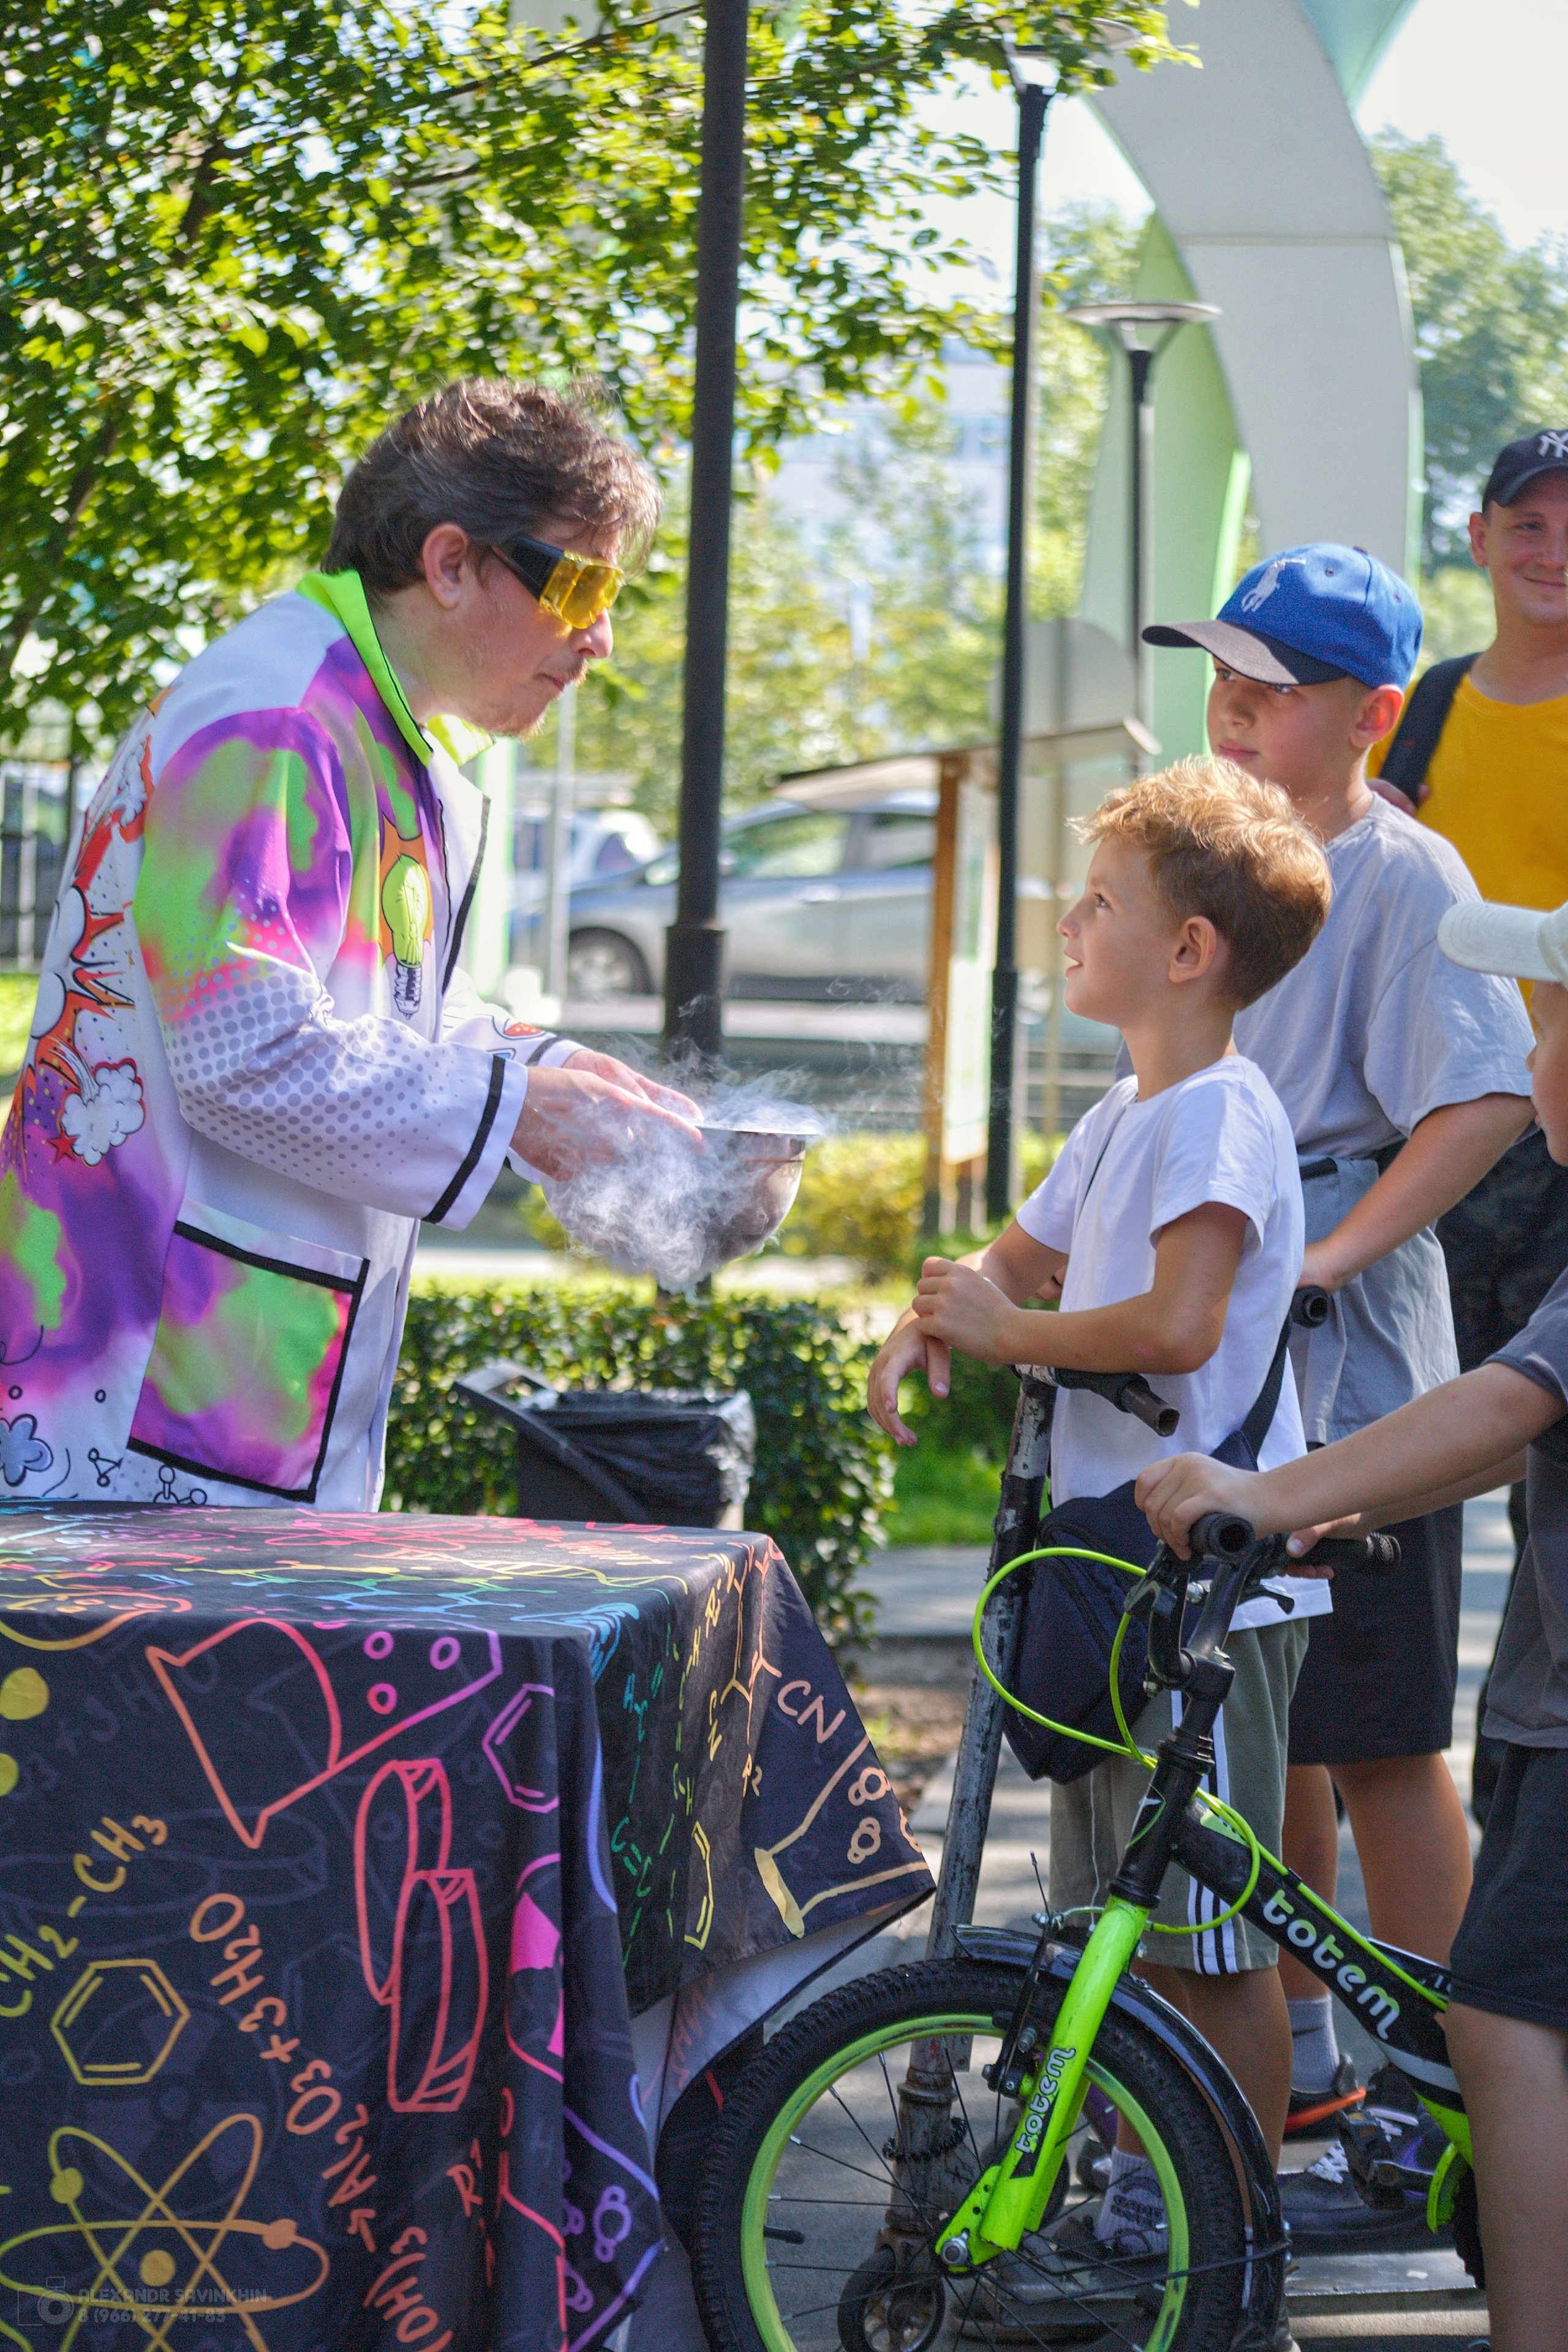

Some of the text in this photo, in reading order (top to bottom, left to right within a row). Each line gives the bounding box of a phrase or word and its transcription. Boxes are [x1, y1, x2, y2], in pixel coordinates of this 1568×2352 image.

[775, 1680, 846, 1744] CN
[1263, 1889, 1400, 2040] totem
[1015, 2048, 1076, 2153] totem
